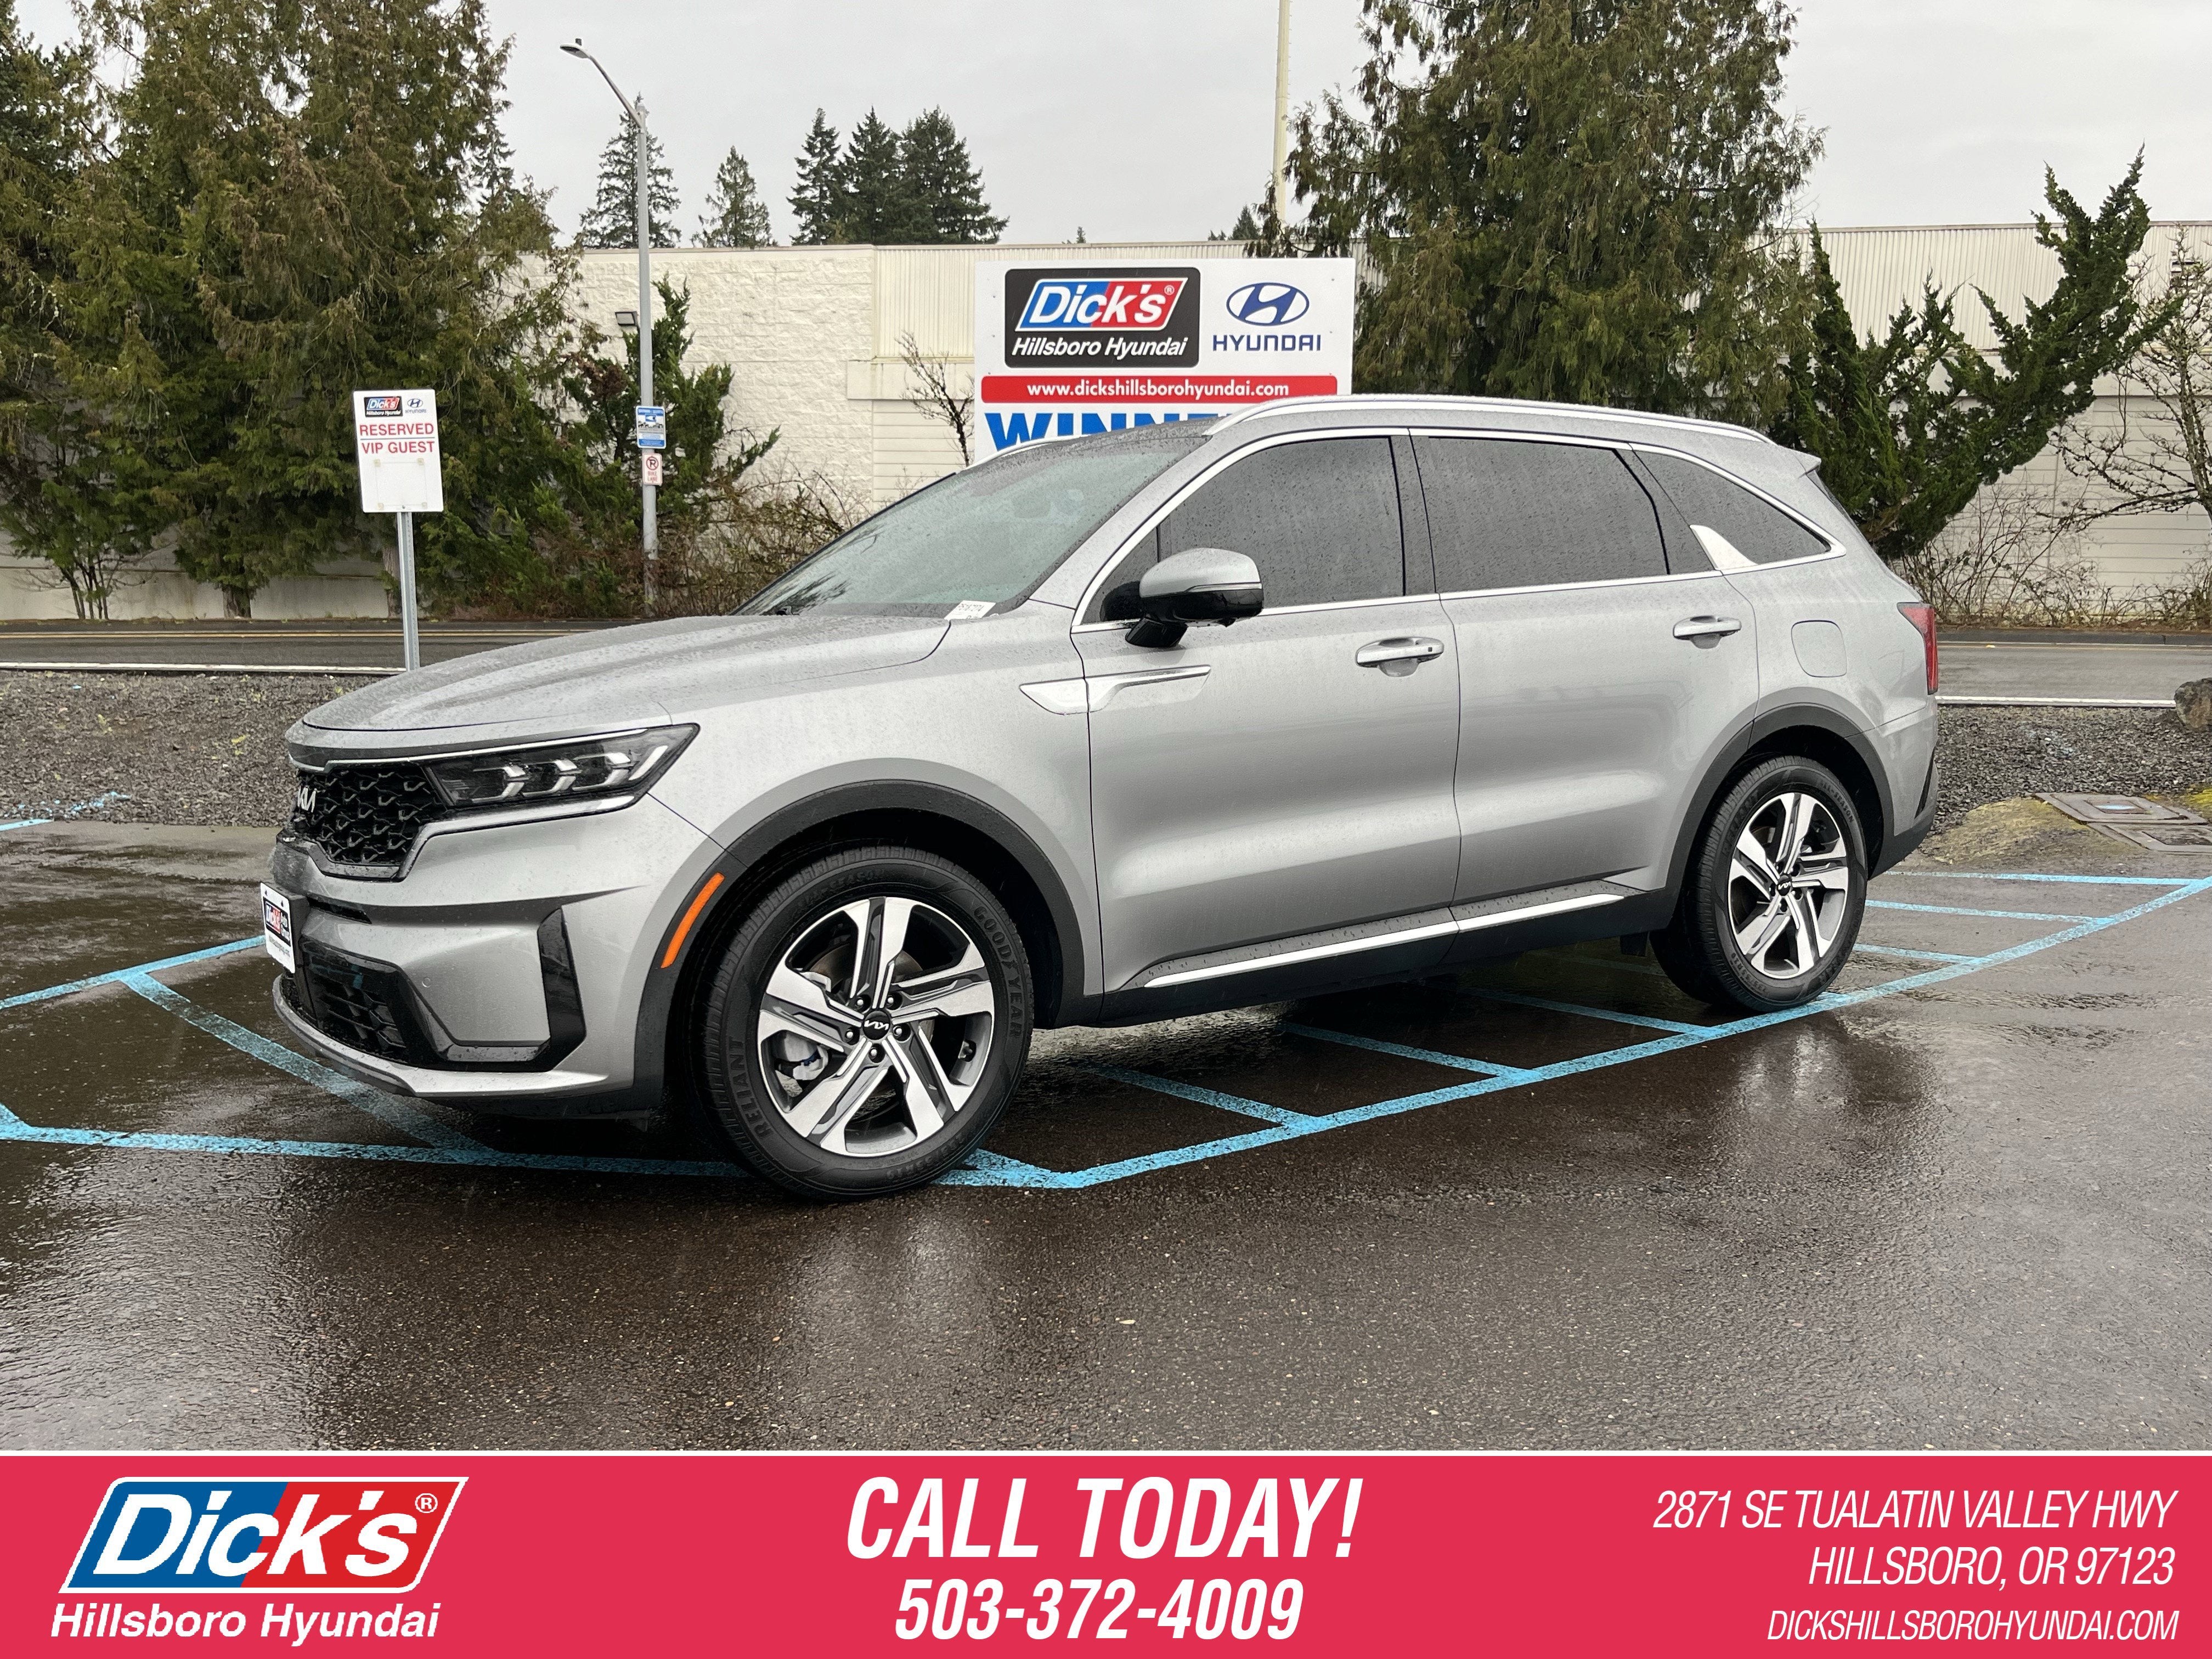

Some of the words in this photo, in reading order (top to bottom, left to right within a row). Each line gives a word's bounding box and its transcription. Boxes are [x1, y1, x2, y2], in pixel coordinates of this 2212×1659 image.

[1012, 338, 1101, 357] Hillsboro
[1104, 336, 1188, 360] Hyundai
[1212, 335, 1321, 352] HYUNDAI
[1027, 379, 1289, 400] www.dickshillsborohyundai.com
[359, 423, 434, 436] RESERVED
[362, 442, 383, 454] VIP
[388, 441, 435, 454] GUEST
[973, 906, 1023, 1037] GOODYEAR
[729, 1039, 775, 1138] RELIANT
